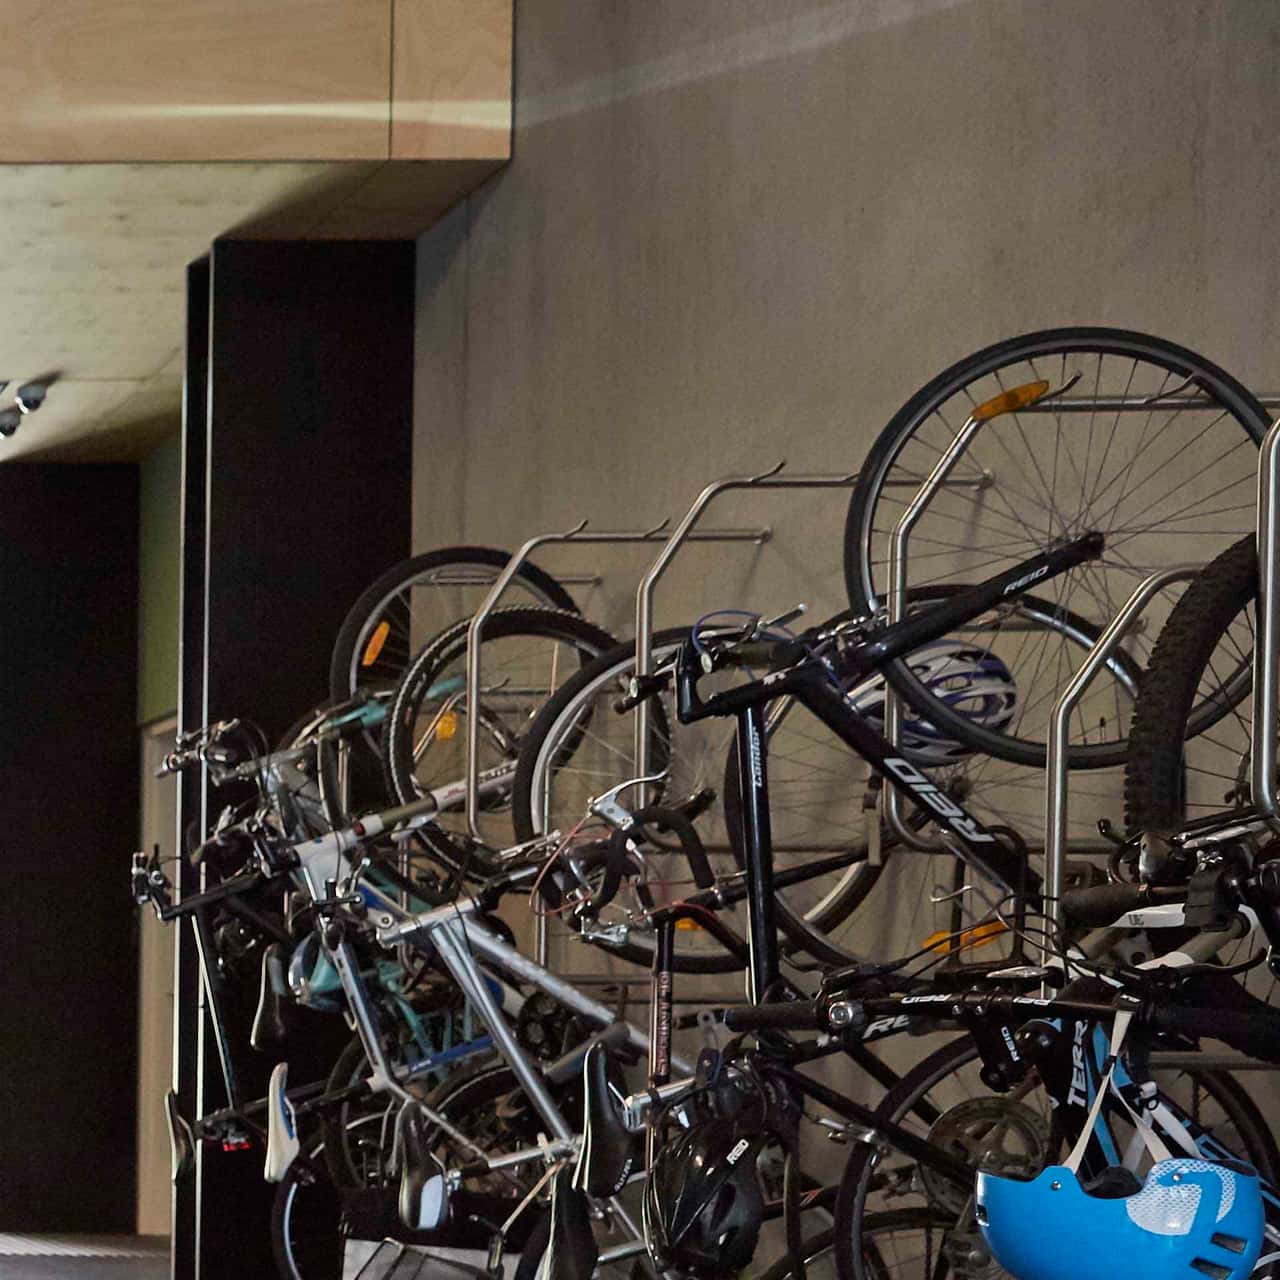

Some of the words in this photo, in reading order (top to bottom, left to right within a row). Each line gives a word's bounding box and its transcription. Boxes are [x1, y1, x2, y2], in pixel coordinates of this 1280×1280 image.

[1002, 565, 1049, 596] REID
[885, 757, 996, 844] REID
[862, 1013, 911, 1040] RE
[1000, 1026, 1021, 1063] REID
[1067, 1019, 1089, 1107] TERR
[725, 1138, 750, 1165] REID
